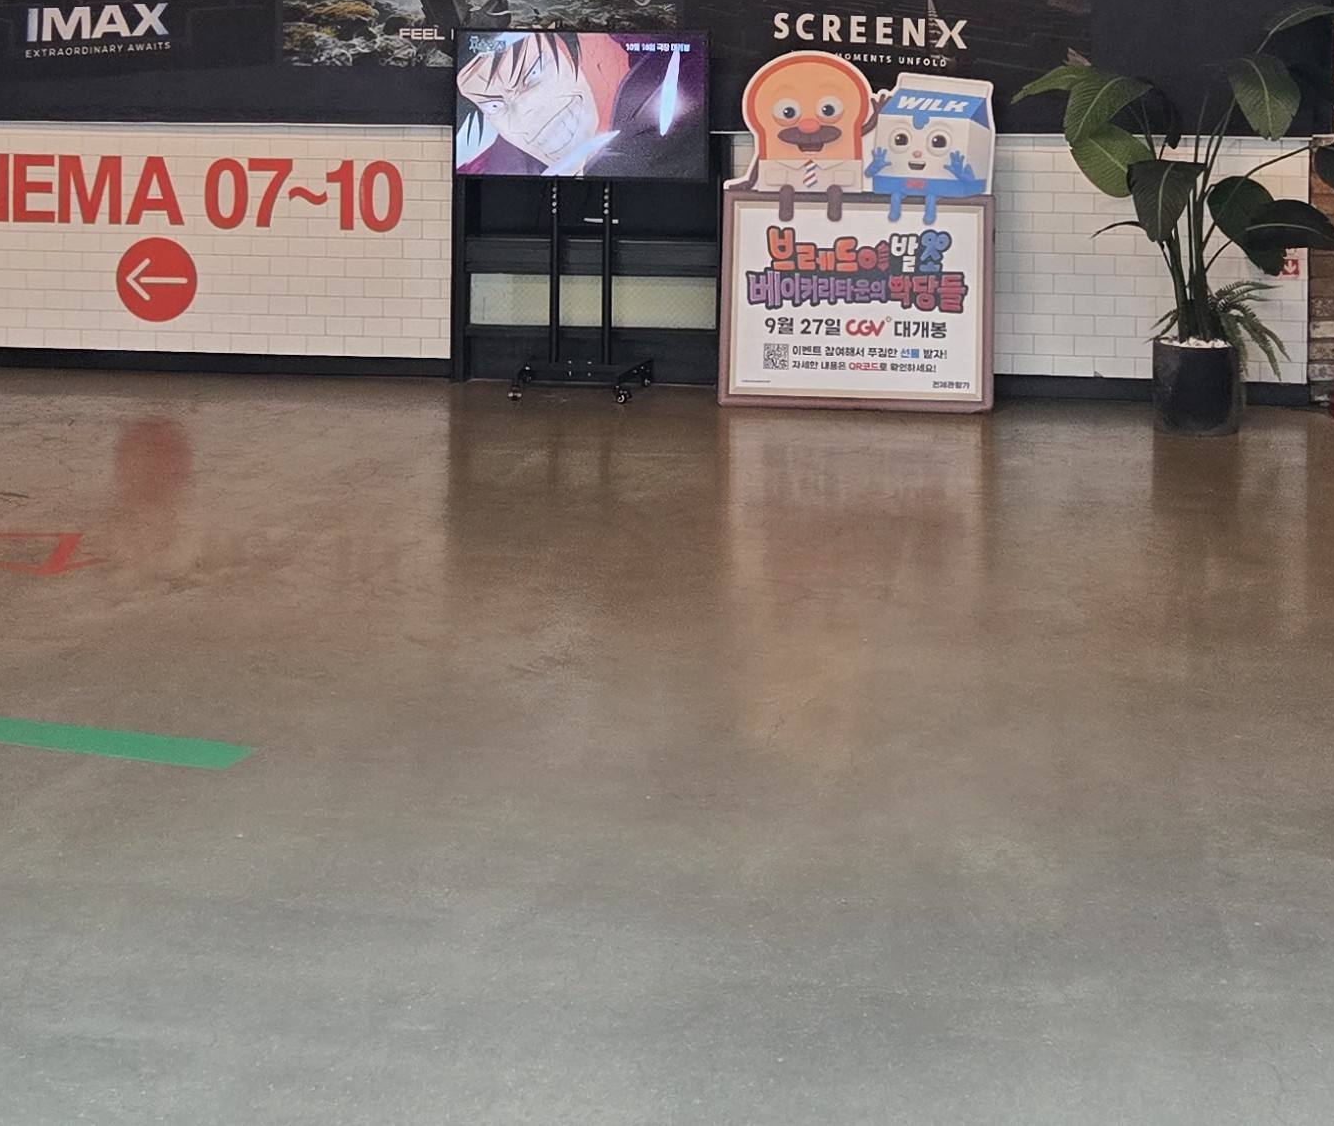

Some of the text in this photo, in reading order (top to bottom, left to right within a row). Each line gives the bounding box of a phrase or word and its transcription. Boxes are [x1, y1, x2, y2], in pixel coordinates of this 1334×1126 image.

[26, 2, 170, 43] IMAX
[398, 27, 446, 41] FEEL
[25, 41, 172, 59] EXTRAORDINARY AWAITS
[898, 55, 947, 68] UNFOLD
[896, 95, 969, 113] WILK
[203, 157, 405, 234] 07~10
[746, 269, 968, 314] 베이커리타운의 악당들
[764, 317, 948, 340] 9월 27일 CGV 대개봉
[792, 345, 822, 357] 이벤트
[825, 345, 865, 358] 참여해서
[867, 347, 898, 359] 푸짐한
[923, 348, 948, 360] 받자!
[791, 360, 937, 373] 자세한 내용은 QR코드로 확인하세요!
